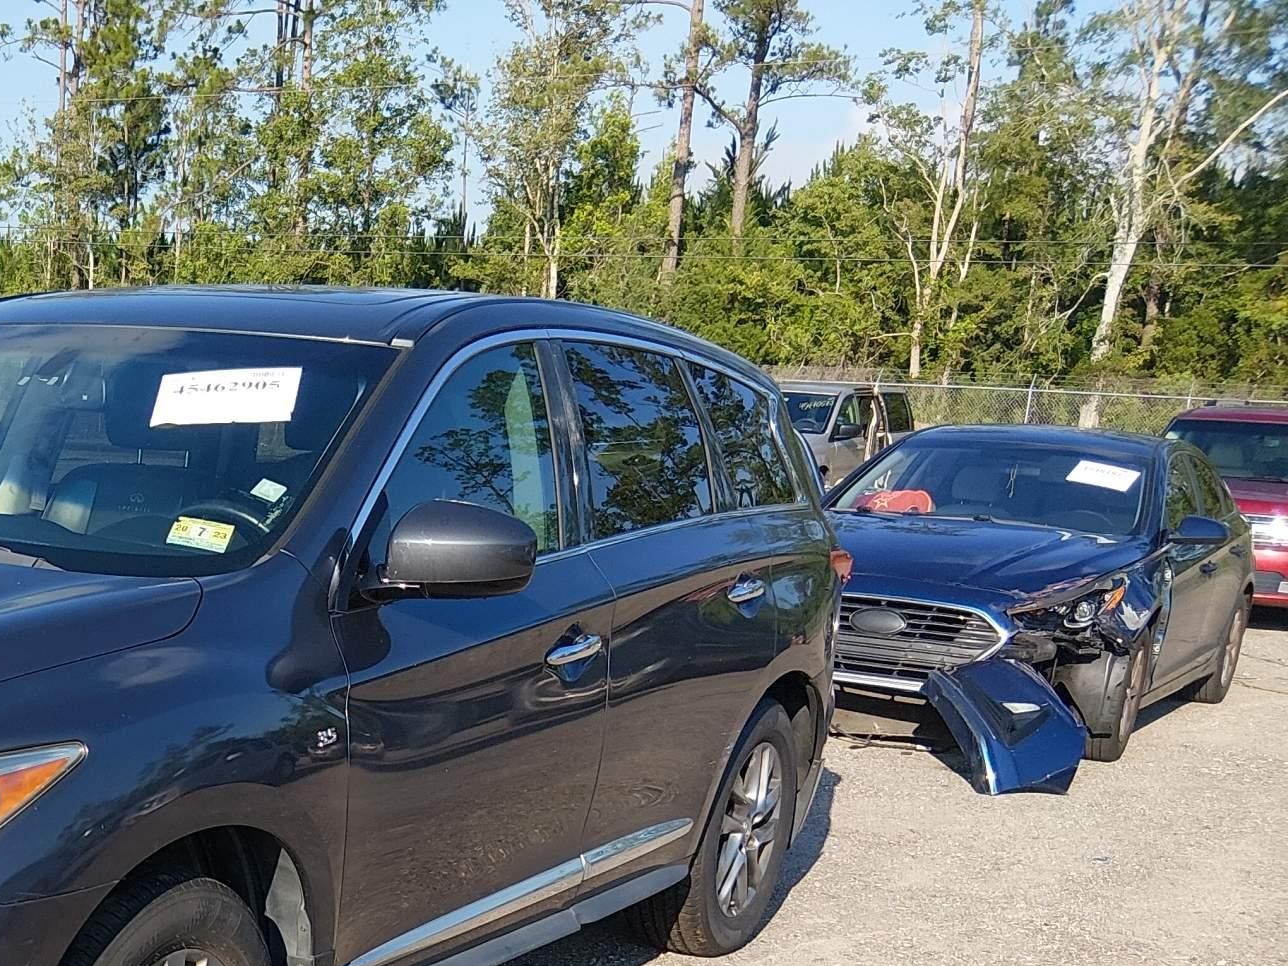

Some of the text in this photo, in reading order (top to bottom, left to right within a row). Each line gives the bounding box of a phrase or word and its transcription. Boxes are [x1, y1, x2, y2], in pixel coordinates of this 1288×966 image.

[172, 380, 281, 395] 45462905
[197, 526, 207, 537] 7
[213, 531, 228, 540] 23
